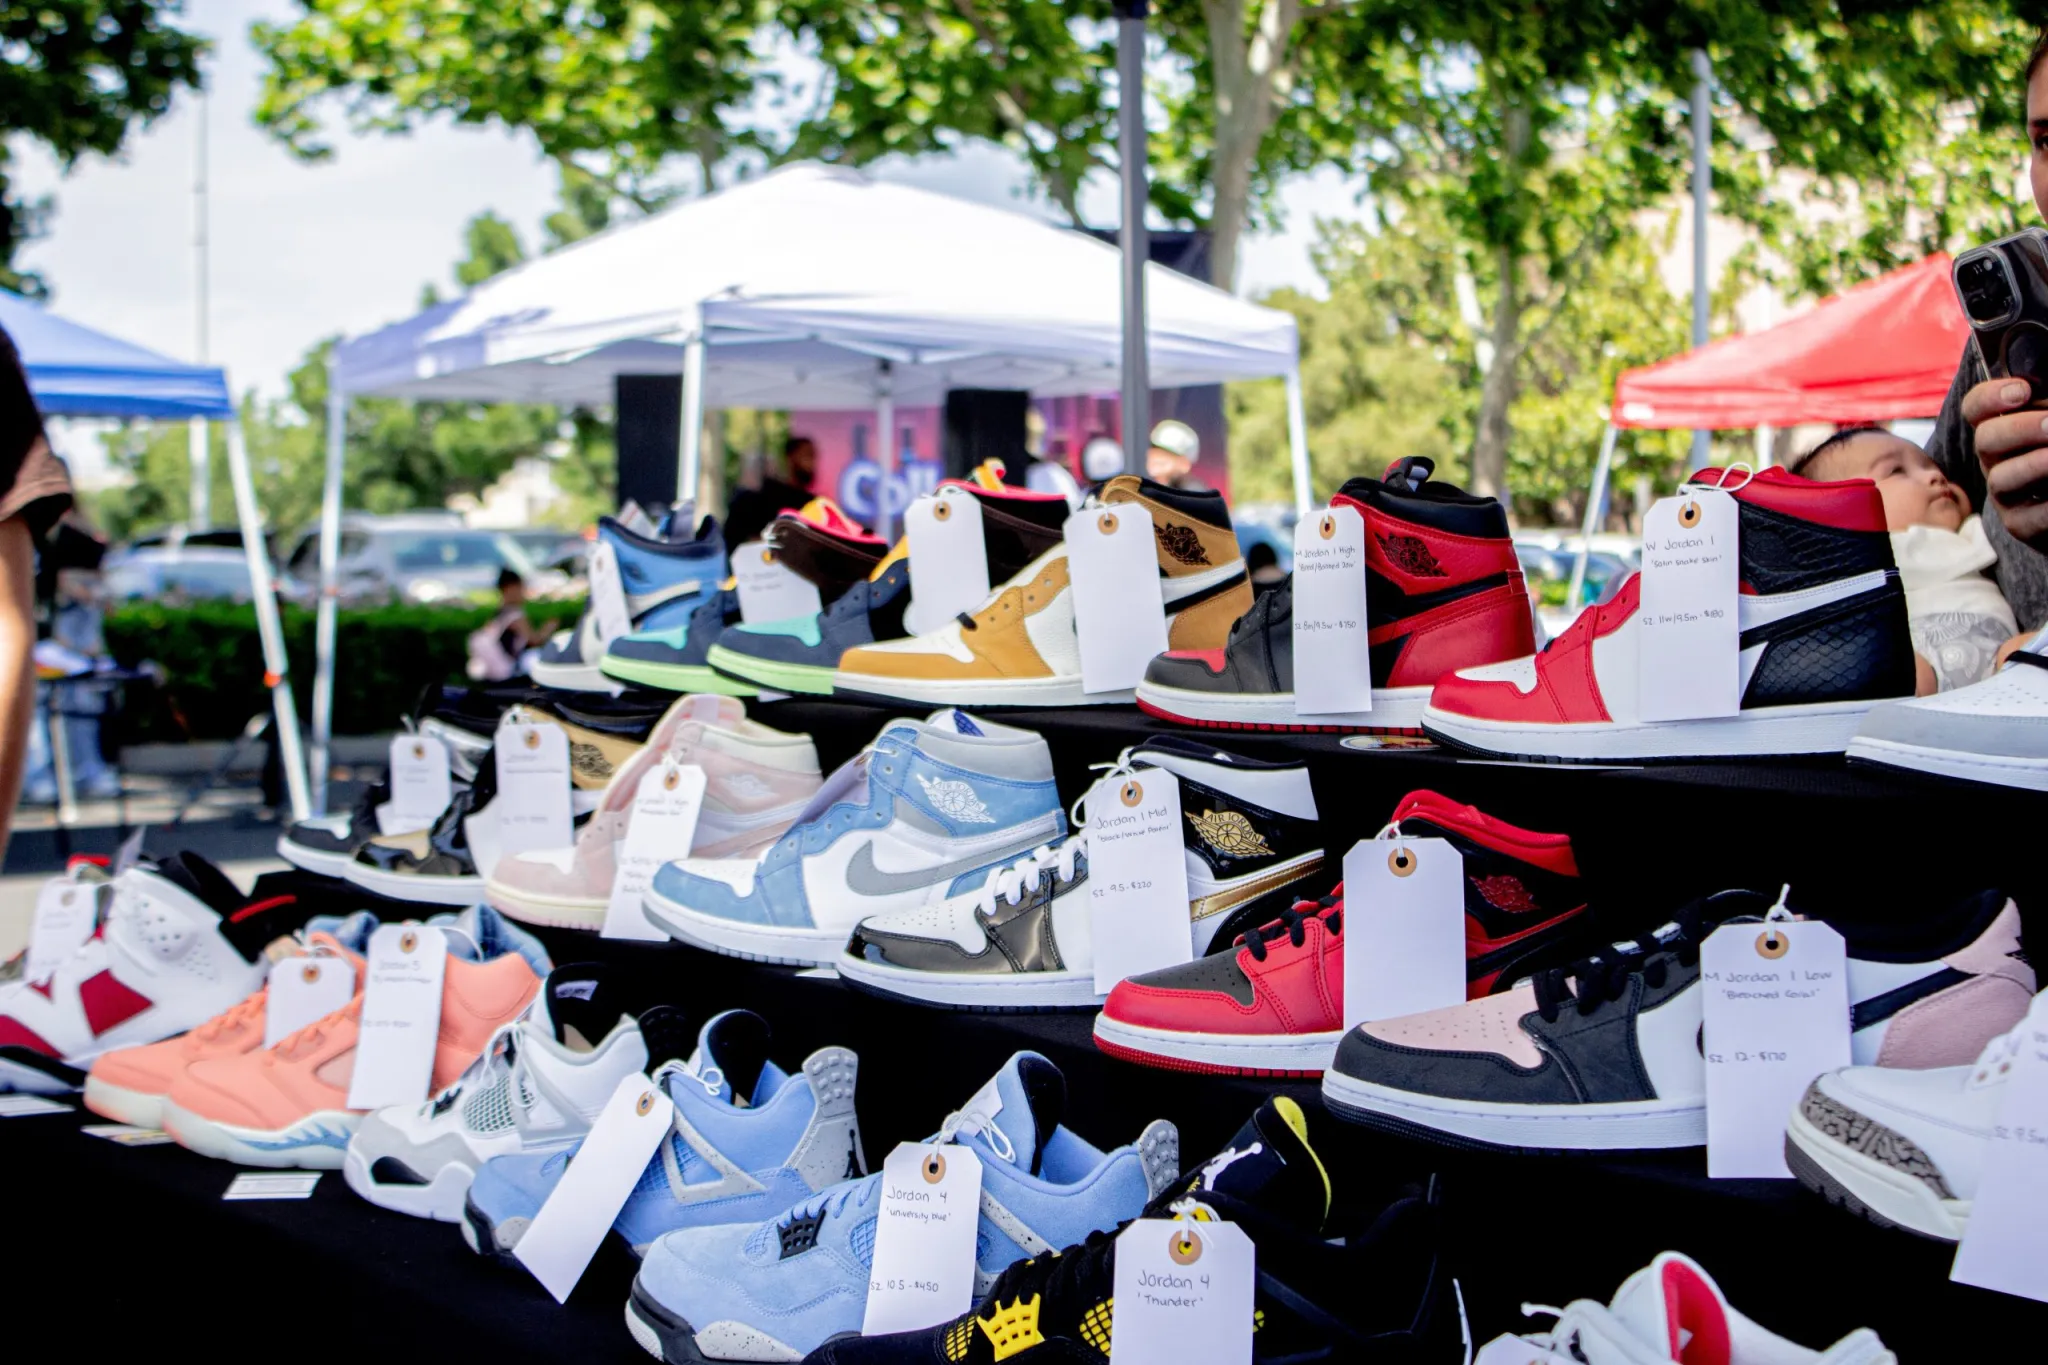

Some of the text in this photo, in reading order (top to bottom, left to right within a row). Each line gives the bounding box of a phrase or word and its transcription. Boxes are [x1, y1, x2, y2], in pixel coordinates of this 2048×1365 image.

[1645, 541, 1656, 551] W
[1664, 538, 1703, 551] Jordan
[1304, 548, 1330, 559] Jordan
[1339, 545, 1356, 559] High
[1096, 815, 1137, 830] Jordan
[1147, 806, 1168, 820] Mid
[1205, 813, 1226, 823] AIR
[1704, 972, 1720, 981] M
[1726, 972, 1780, 983] Jordan
[1805, 970, 1832, 981] Low
[886, 1185, 948, 1204] Jordan 4
[1137, 1269, 1210, 1291] Jordan 4
